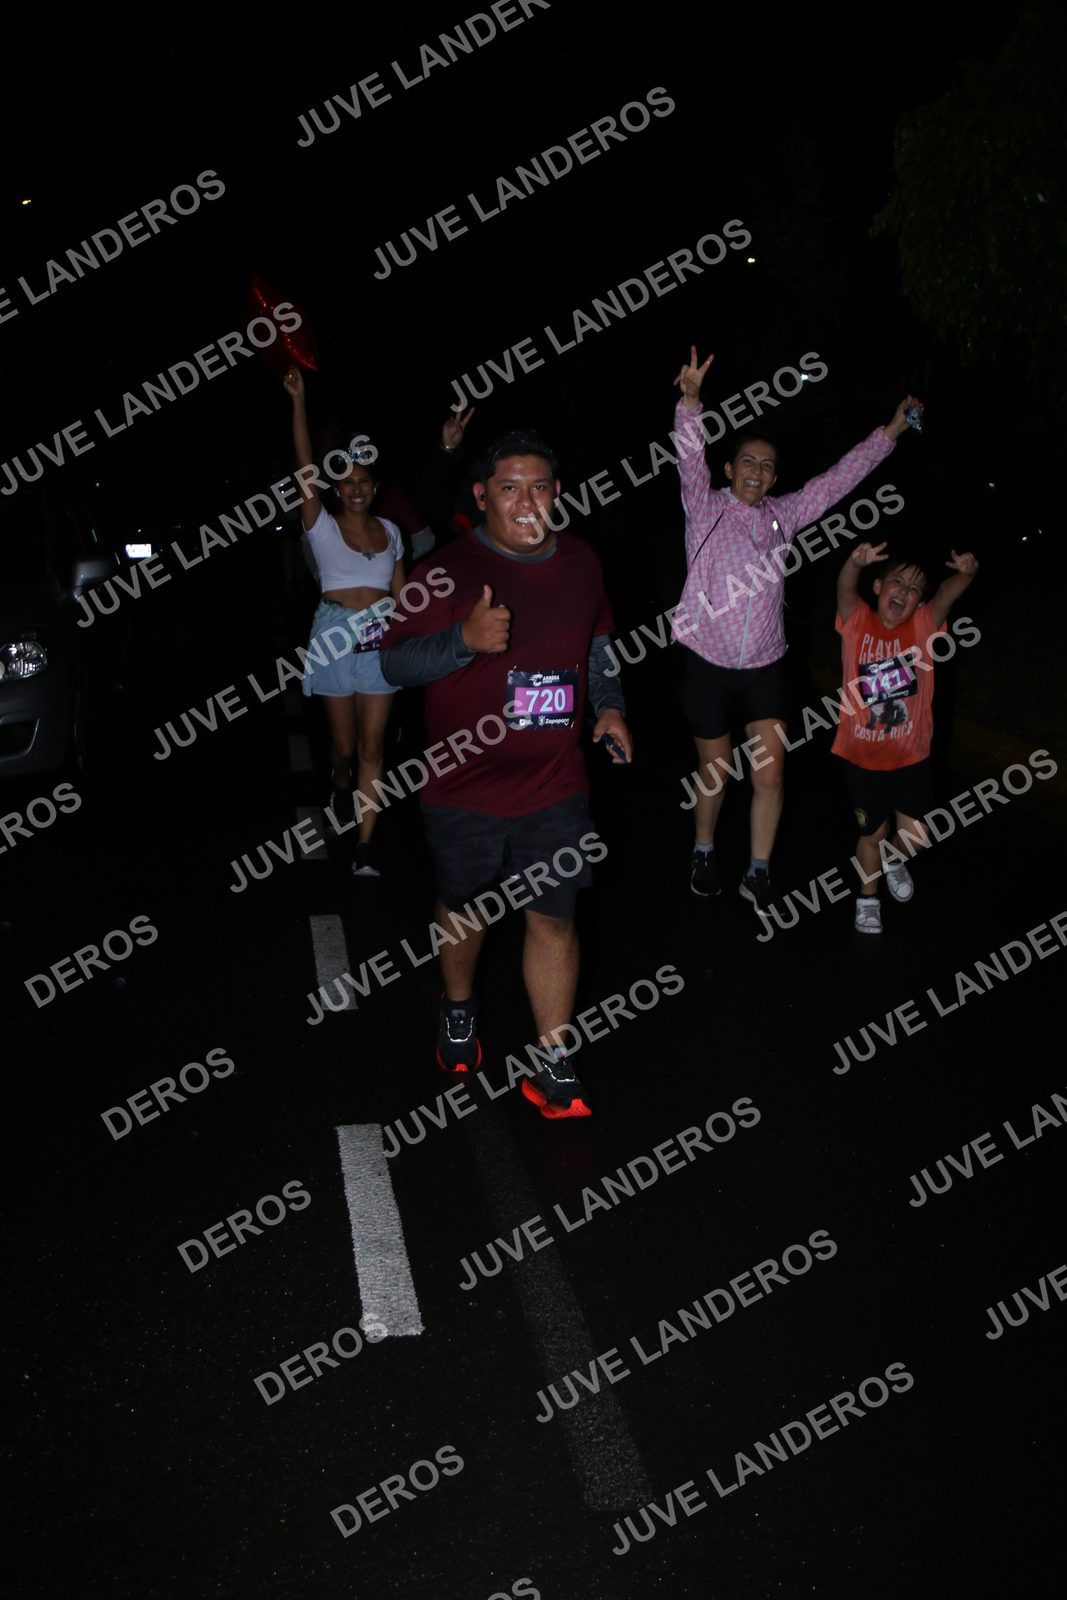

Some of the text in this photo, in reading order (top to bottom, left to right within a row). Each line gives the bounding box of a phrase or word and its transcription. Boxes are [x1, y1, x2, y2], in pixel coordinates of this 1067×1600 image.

[526, 688, 566, 713] 720
[854, 720, 914, 742] COSTA RICA
